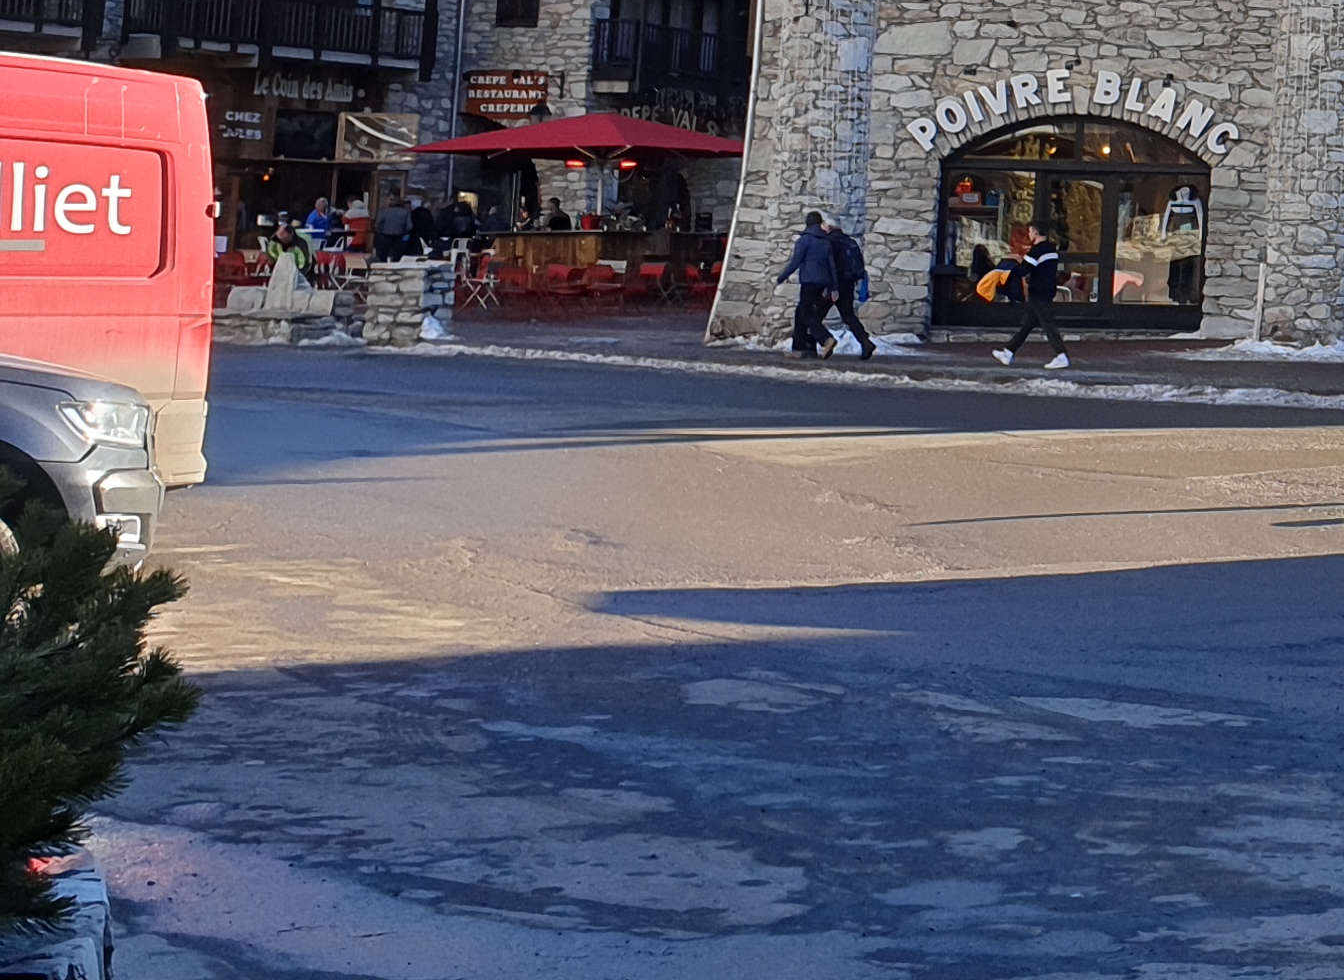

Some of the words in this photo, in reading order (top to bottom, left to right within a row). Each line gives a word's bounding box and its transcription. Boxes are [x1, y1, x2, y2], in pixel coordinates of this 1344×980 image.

[253, 71, 269, 96] Le
[272, 72, 299, 99] Coin
[302, 74, 323, 100] des
[470, 75, 507, 85] CREPE
[468, 89, 545, 99] RESTAURANT
[225, 110, 261, 123] CHEZ
[906, 68, 1072, 153] POIVRE
[1092, 70, 1240, 155] BLANC
[0, 161, 132, 234] liet
